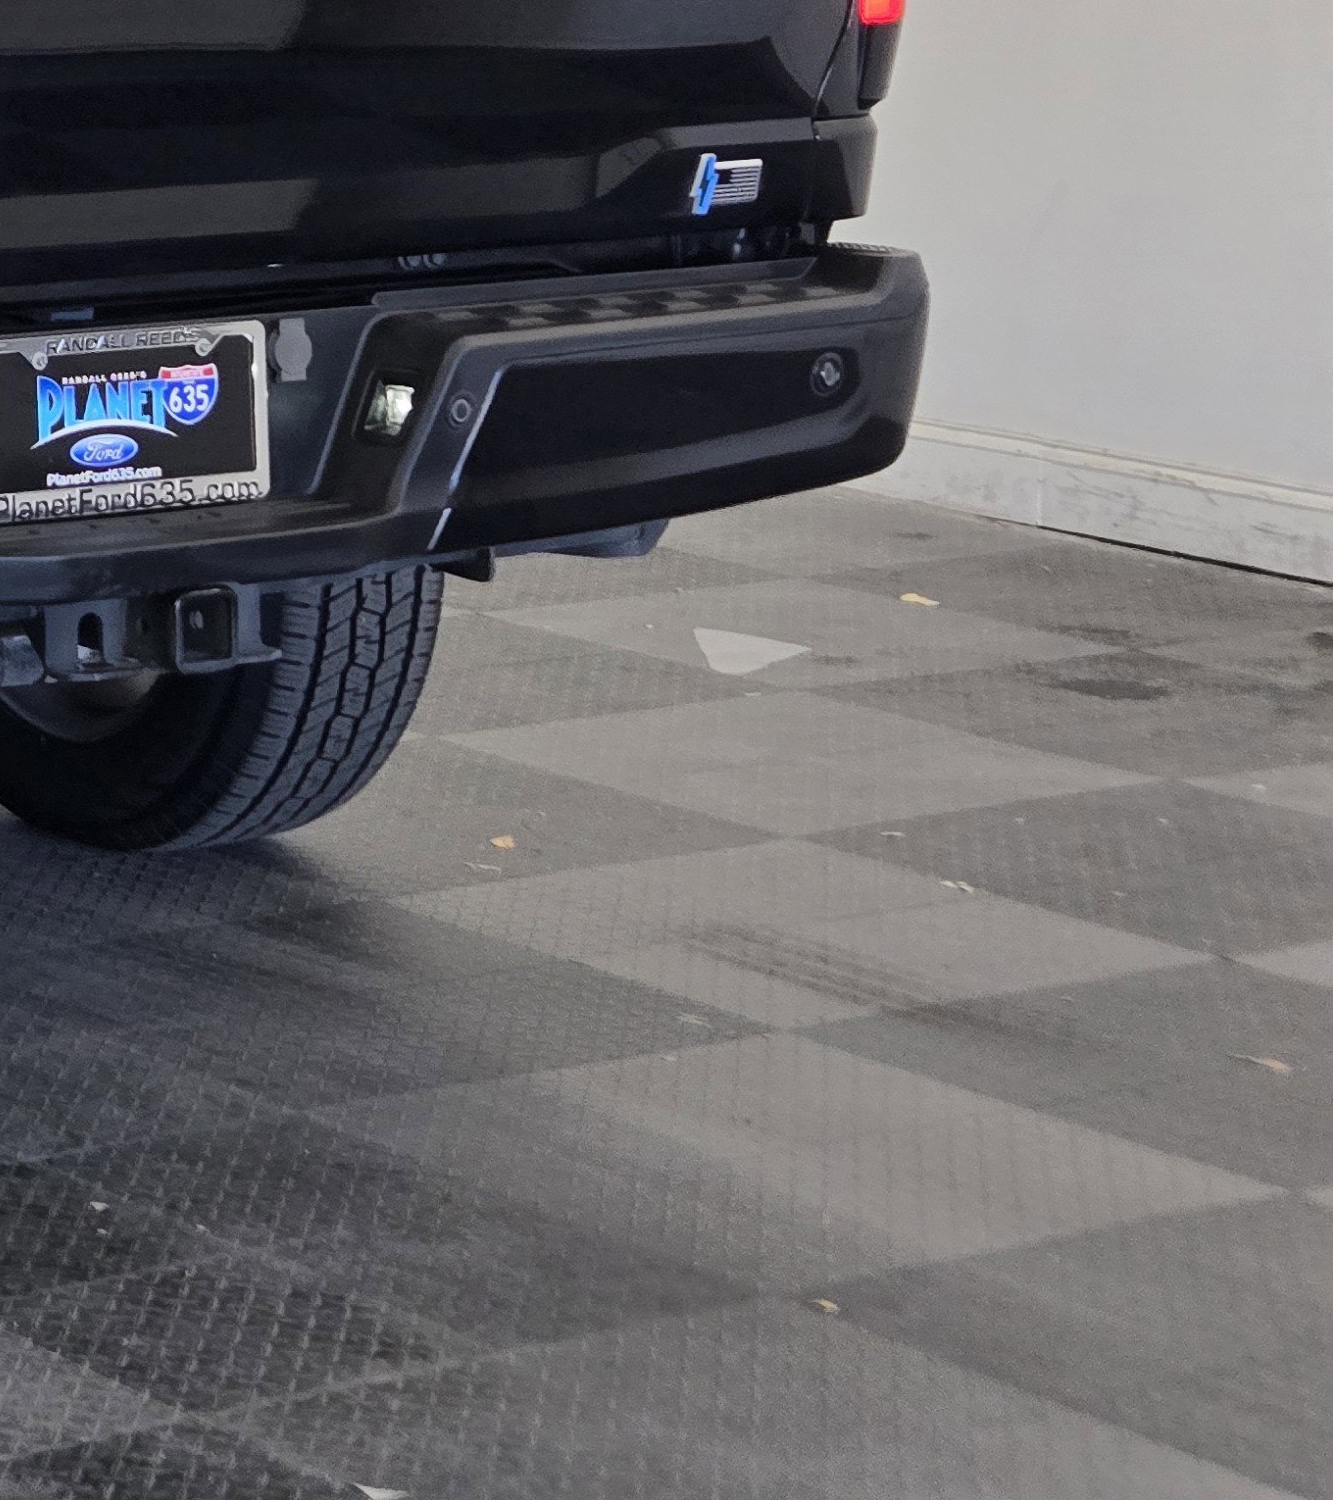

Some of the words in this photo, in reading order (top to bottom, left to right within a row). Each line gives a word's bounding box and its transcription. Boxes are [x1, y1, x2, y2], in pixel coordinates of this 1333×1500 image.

[46, 334, 130, 353] RANDALL
[37, 375, 167, 441] PLANET
[169, 384, 209, 414] 635
[83, 439, 124, 462] Ford
[47, 466, 162, 487] PlanetFord635.com
